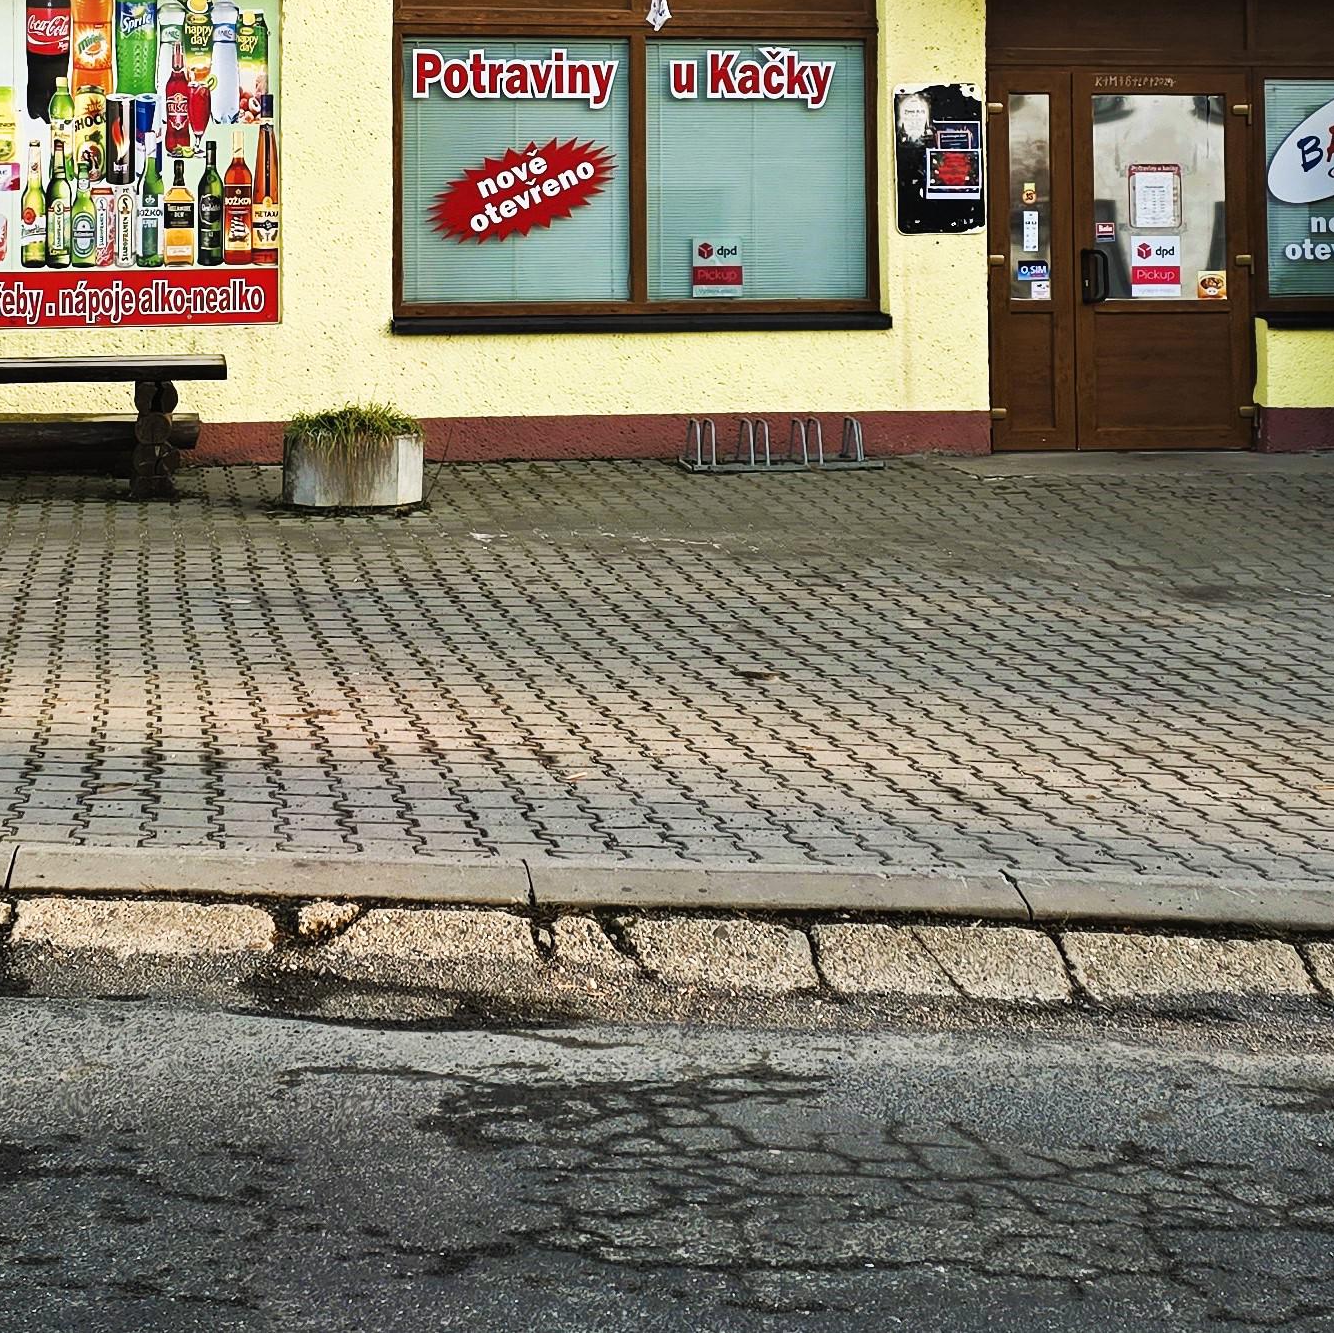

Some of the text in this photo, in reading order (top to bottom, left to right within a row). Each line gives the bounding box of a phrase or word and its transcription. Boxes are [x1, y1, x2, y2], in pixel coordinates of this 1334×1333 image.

[121, 13, 152, 34] Sprite
[185, 25, 214, 38] happy
[190, 34, 209, 46] day
[413, 47, 836, 109] Potraviny u Kačky
[476, 148, 548, 199] nově
[470, 161, 595, 233] otevřeno
[717, 245, 738, 258] dpd
[1155, 246, 1175, 258] dpd
[698, 269, 738, 282] Pickup
[1136, 269, 1176, 282] Pickup
[59, 280, 136, 323] nápoje
